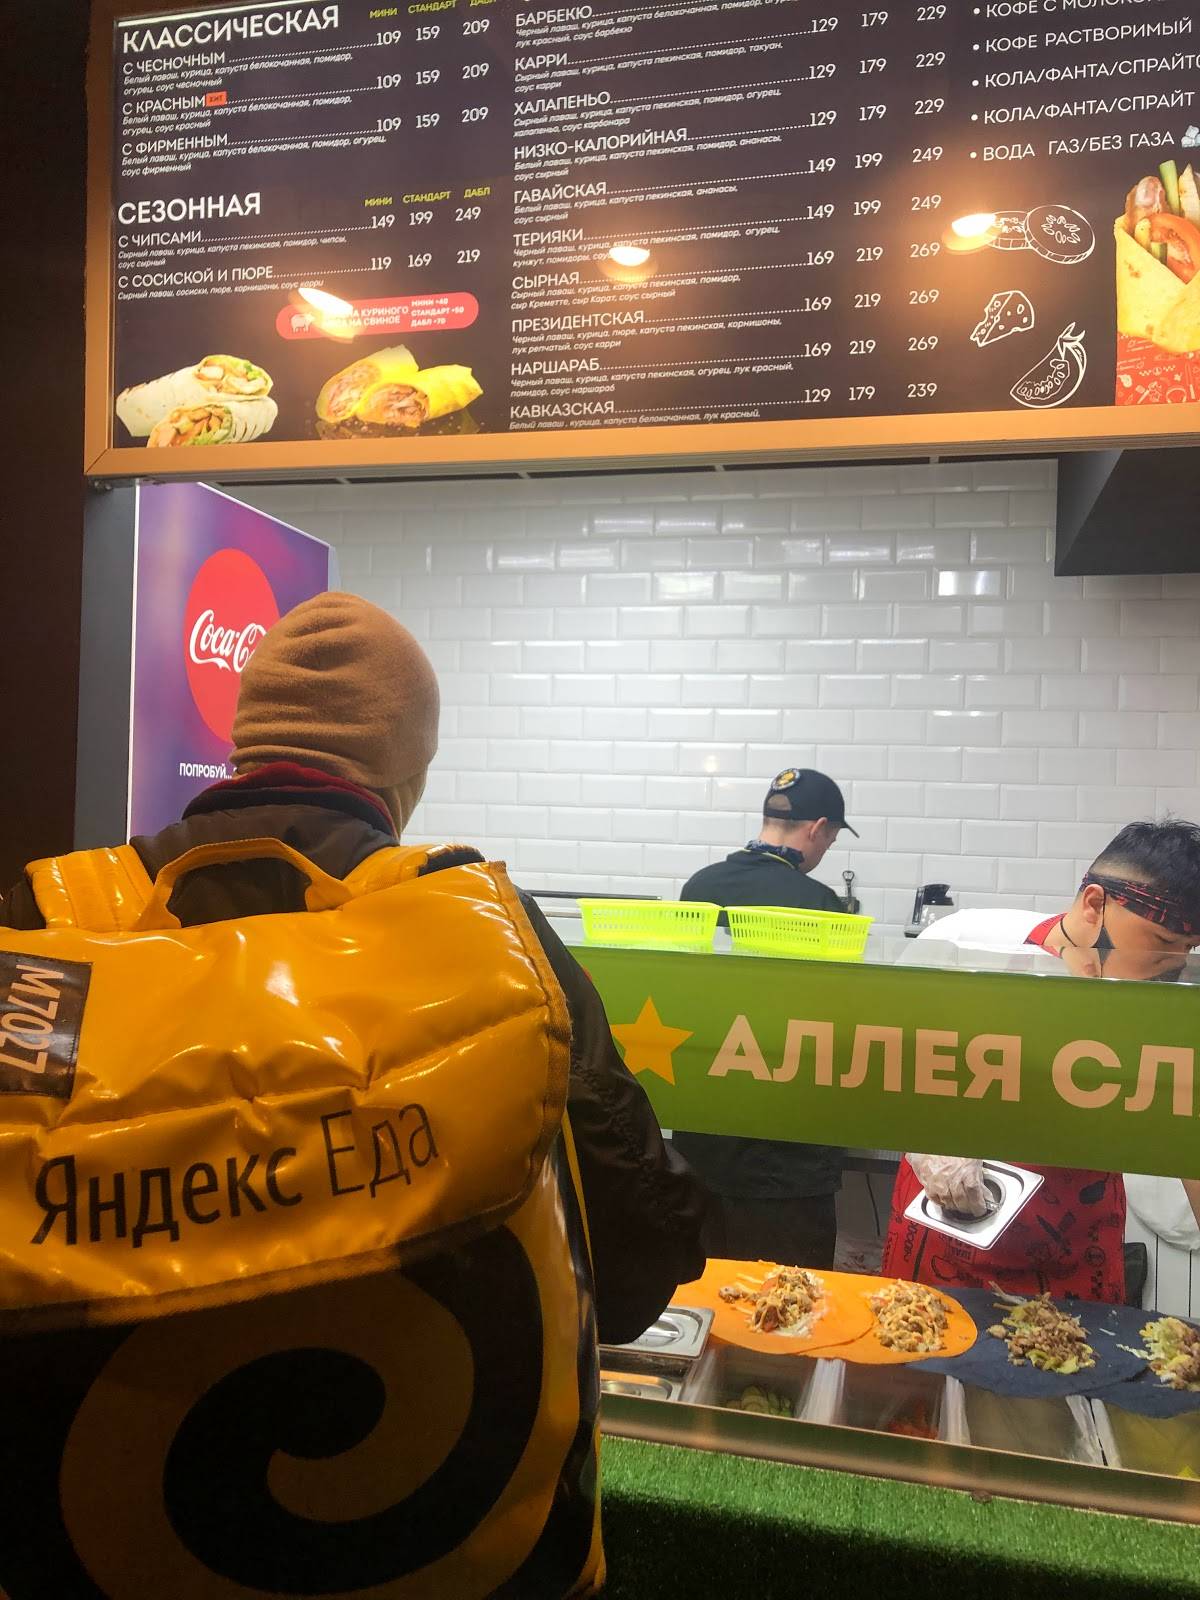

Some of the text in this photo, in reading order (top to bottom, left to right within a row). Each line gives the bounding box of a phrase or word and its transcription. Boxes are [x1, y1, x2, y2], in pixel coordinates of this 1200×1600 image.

[123, 5, 338, 54] КЛАССИЧЕСКАЯ
[369, 7, 397, 19] МИНИ
[407, 0, 456, 14] СТАНДАРТ
[515, 4, 594, 27] БАРБЕКЮ
[986, 1, 1037, 18] КОФЕ
[1043, 0, 1056, 13] С
[122, 19, 489, 75] С ЧЕСНОЧНЫМ 109 159 209
[515, 5, 946, 71] КАРРИ 129 179 229
[986, 18, 1191, 53] КОФЕ РАСТВОРИМЫЙ
[122, 102, 132, 115] С
[136, 93, 208, 114] КРАСНЫМ
[377, 73, 401, 90] 109
[416, 68, 440, 85] 159
[462, 63, 489, 80] 209
[513, 51, 945, 116] ХАЛАПЕНЬО 129 179 229
[514, 99, 944, 160] НИЗКО-КАЛОРИЙНАЯ 129 179 229
[984, 90, 1194, 125] КОЛА/ФАНТА/СПРАЙТ
[121, 106, 488, 156] С ФИРМЕННЫМ 109 159 209
[983, 131, 1174, 161] ВОДА ГАЗ/БЕЗ ГАЗА
[364, 187, 490, 207] МИНИ СТАНДАРТ ДАБЛ
[514, 147, 942, 204] ГАВАЙСКАЯ 149 199 249
[117, 192, 260, 225] СЕЗОННАЯ
[118, 206, 481, 248] С ЧИПСАМИ 149 199 249
[513, 195, 941, 247] ТЕРИЯКИ 149 199 249
[117, 249, 480, 289] С СОСИСКОЙ И ПЮРЕ 119 169 219
[511, 242, 940, 290] СЫРНАЯ 169 219 269
[512, 289, 939, 333] ПРЕЗИДЕНТСКАЯ 169 219 269
[511, 335, 938, 376] НАРШАРАБ 169 219 269
[510, 382, 937, 419] КАВКАЗСКАЯ 129 179 239
[189, 609, 267, 672] Coca-C
[706, 1014, 1200, 1118] АЛЛЕЯ СЛ
[30, 1103, 440, 1248] Яндекс Еда
